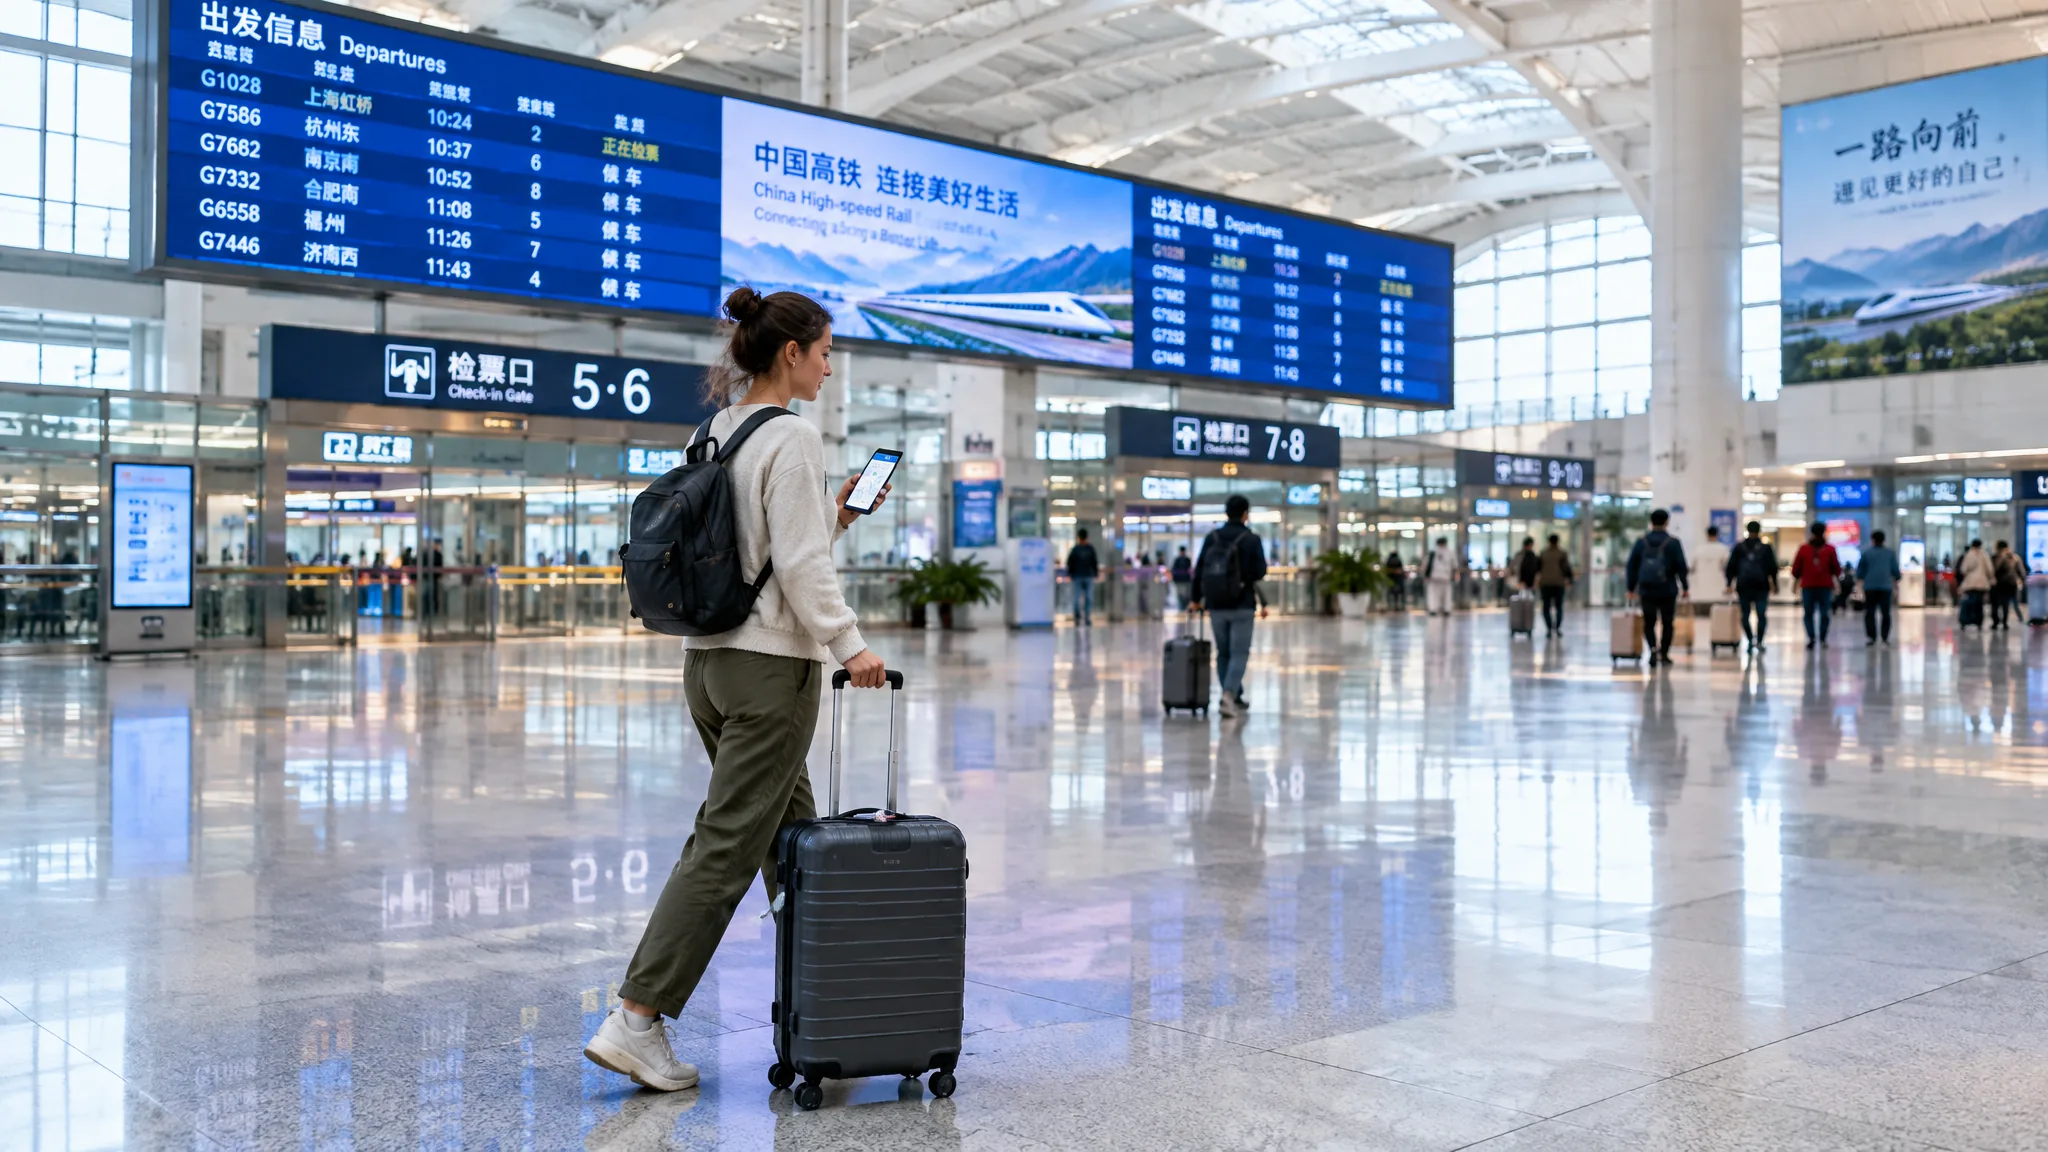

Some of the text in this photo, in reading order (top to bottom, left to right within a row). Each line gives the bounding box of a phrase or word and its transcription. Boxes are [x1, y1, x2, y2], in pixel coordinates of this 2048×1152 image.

[201, 1, 325, 51] 出发信息
[341, 36, 446, 74] Departures
[201, 69, 261, 94] G1028
[201, 100, 261, 125] G7586
[430, 109, 471, 128] 10:24
[305, 116, 359, 142] 杭州东
[531, 126, 541, 142] 2
[201, 133, 260, 158] G7682
[428, 138, 471, 158] 10:37
[531, 154, 541, 170] 6
[200, 166, 259, 190] G7332
[428, 168, 471, 189] 10:52
[754, 140, 1019, 219] 中国高铁 连接美好生活
[531, 183, 540, 199] 8
[754, 181, 912, 223] China High-speed Rail
[200, 198, 259, 222] G6558
[428, 198, 471, 218] 11:08
[1151, 196, 1218, 229] 出发信息
[531, 212, 540, 228] 5
[200, 231, 259, 254] G7446
[428, 228, 471, 248] 11:26
[531, 241, 540, 257] 7
[428, 258, 470, 278] 11:43
[530, 271, 540, 287] 4
[448, 352, 533, 388] 检票口
[449, 384, 533, 403] Check-in Gate
